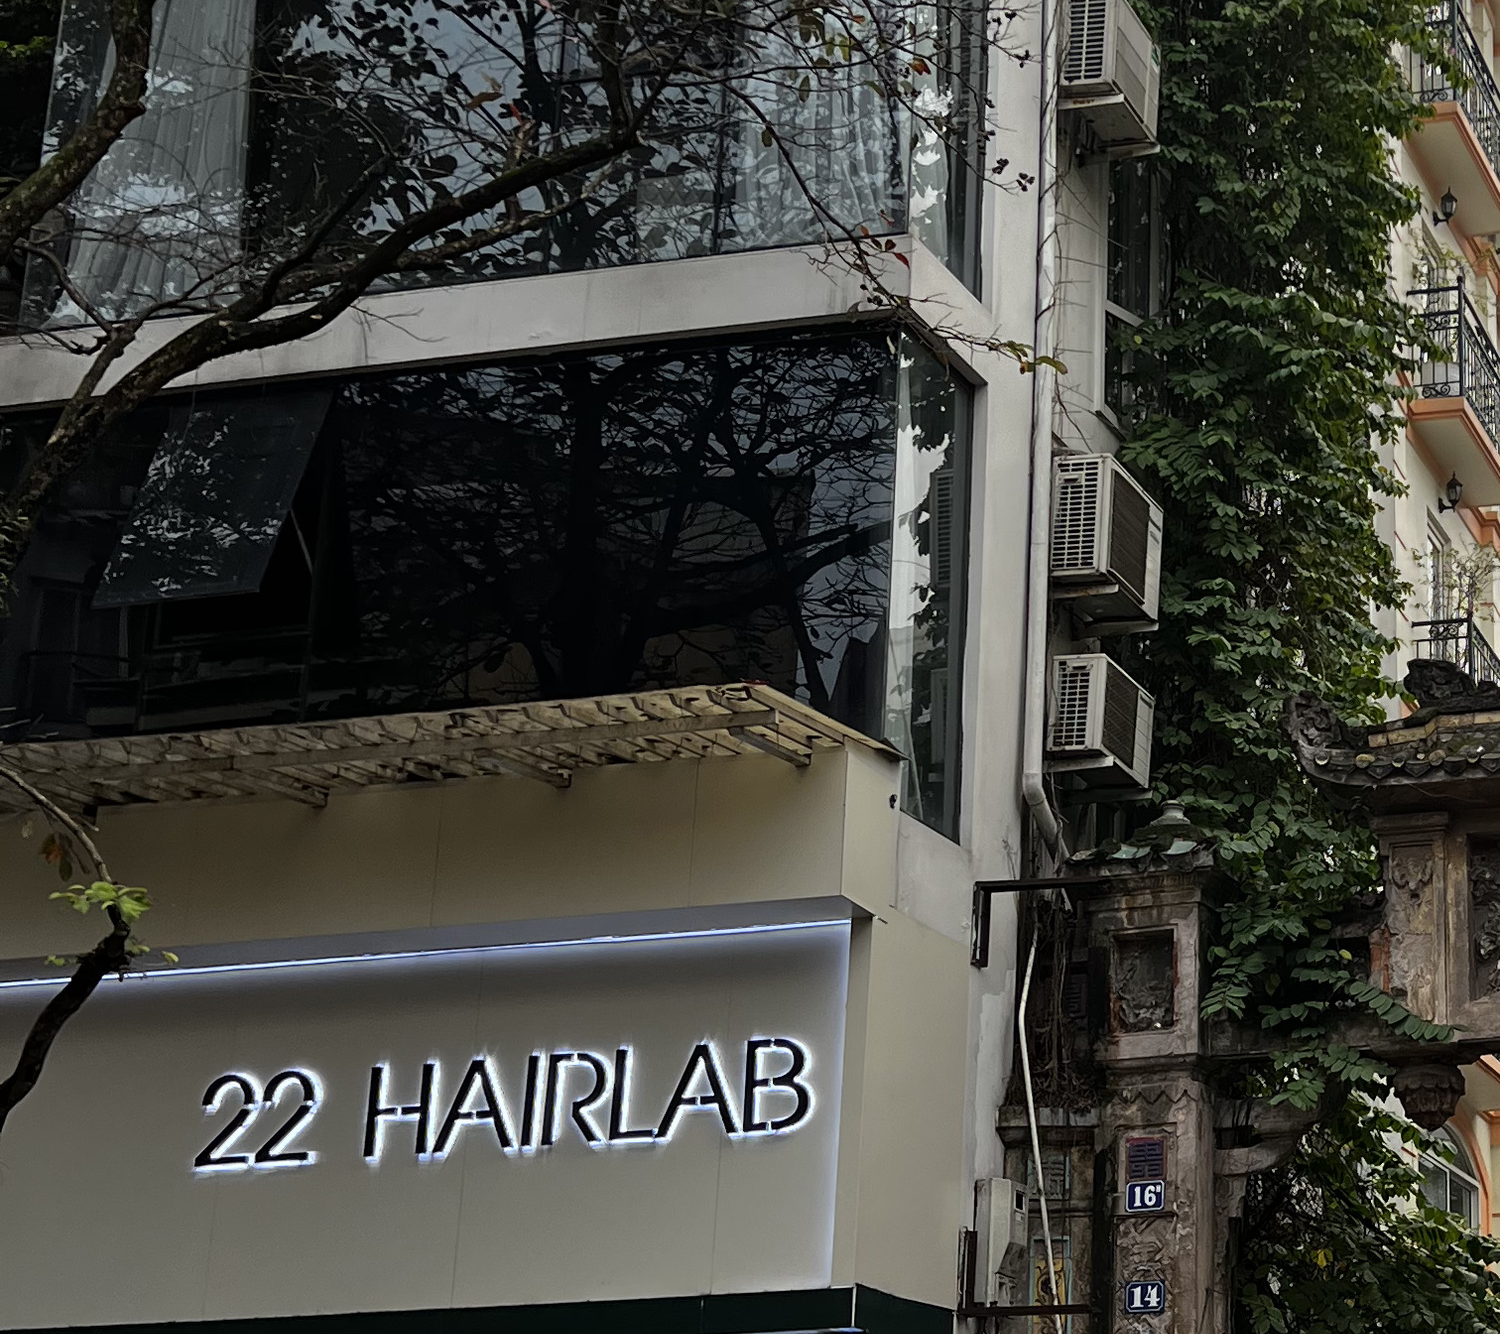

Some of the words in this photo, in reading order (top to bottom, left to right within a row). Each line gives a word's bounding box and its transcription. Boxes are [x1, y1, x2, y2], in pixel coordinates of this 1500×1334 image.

[194, 1070, 320, 1171] 22
[362, 1037, 813, 1159] HAIRLAB
[1130, 1285, 1160, 1309] 14
